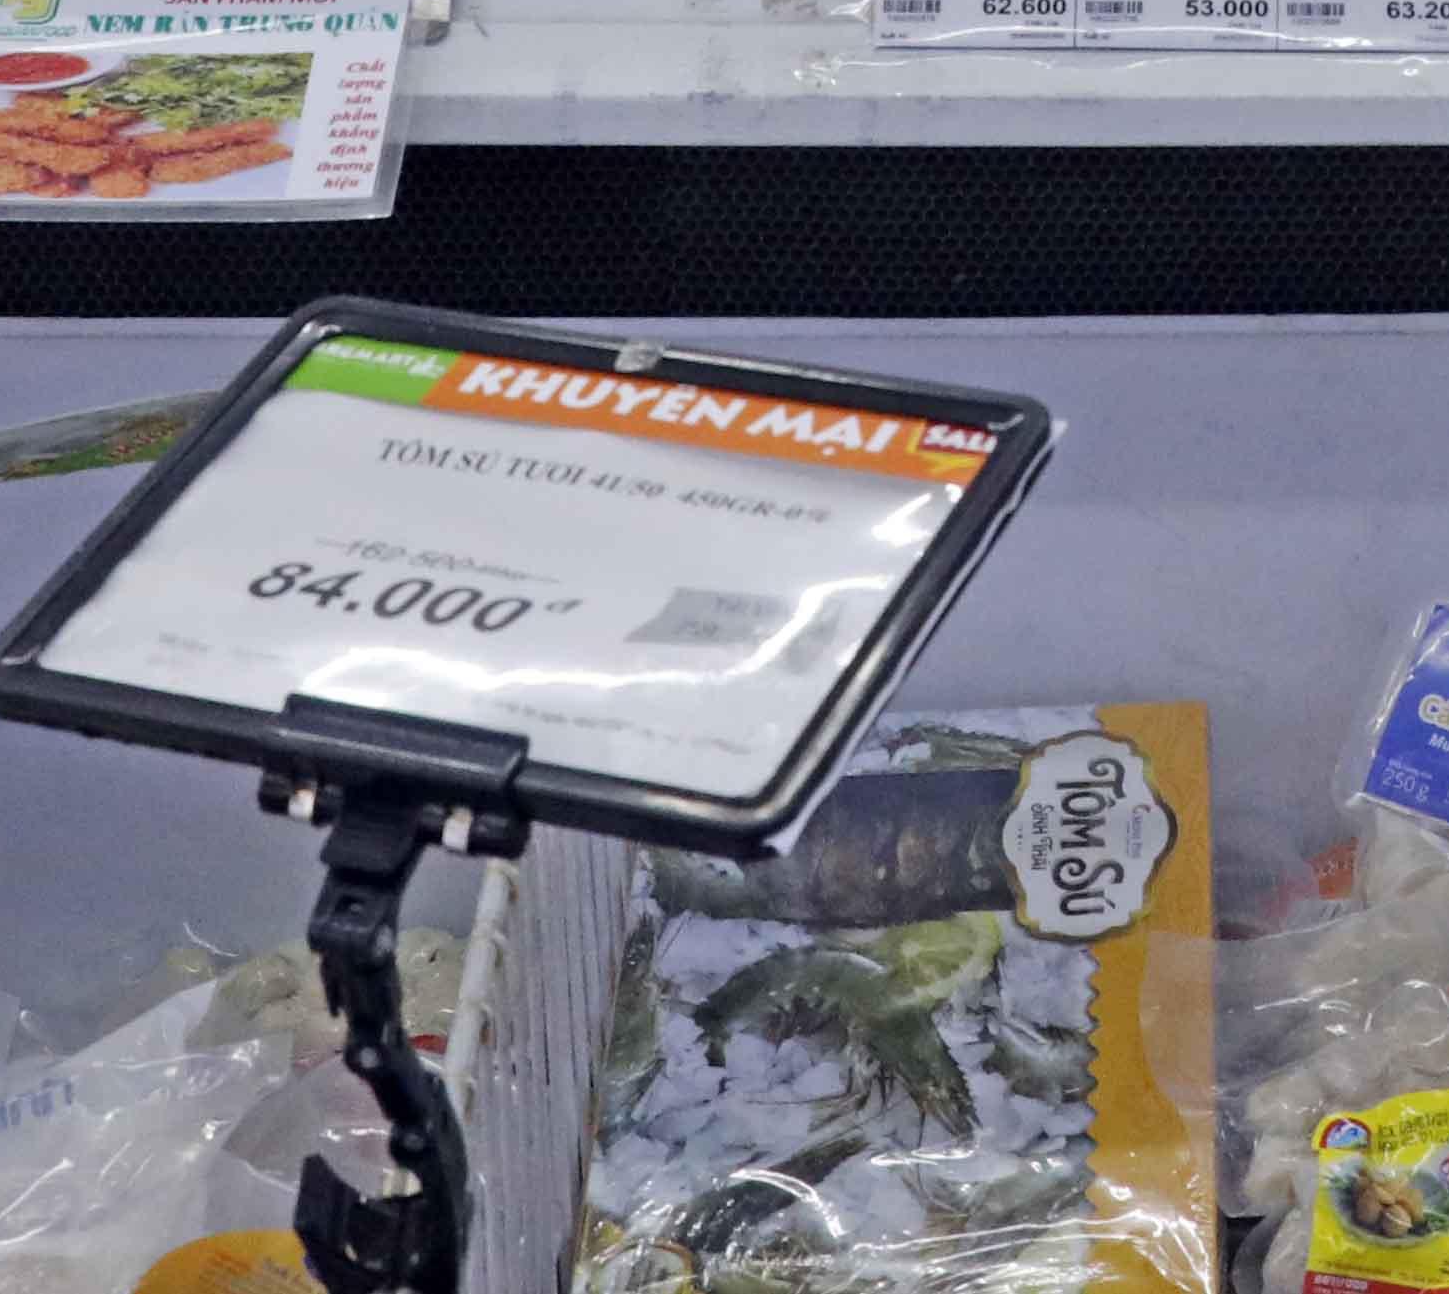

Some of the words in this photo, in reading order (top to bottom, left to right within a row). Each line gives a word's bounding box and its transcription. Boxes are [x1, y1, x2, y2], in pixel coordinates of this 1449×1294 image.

[85, 13, 144, 33] NEM
[221, 13, 317, 32] TRUNG
[1184, 0, 1269, 18] 53.000
[458, 360, 748, 430] KHUYẾN
[746, 404, 902, 456] MẠI
[379, 438, 450, 468] TÔM
[248, 561, 530, 633] 84.000
[1381, 768, 1417, 794] 250
